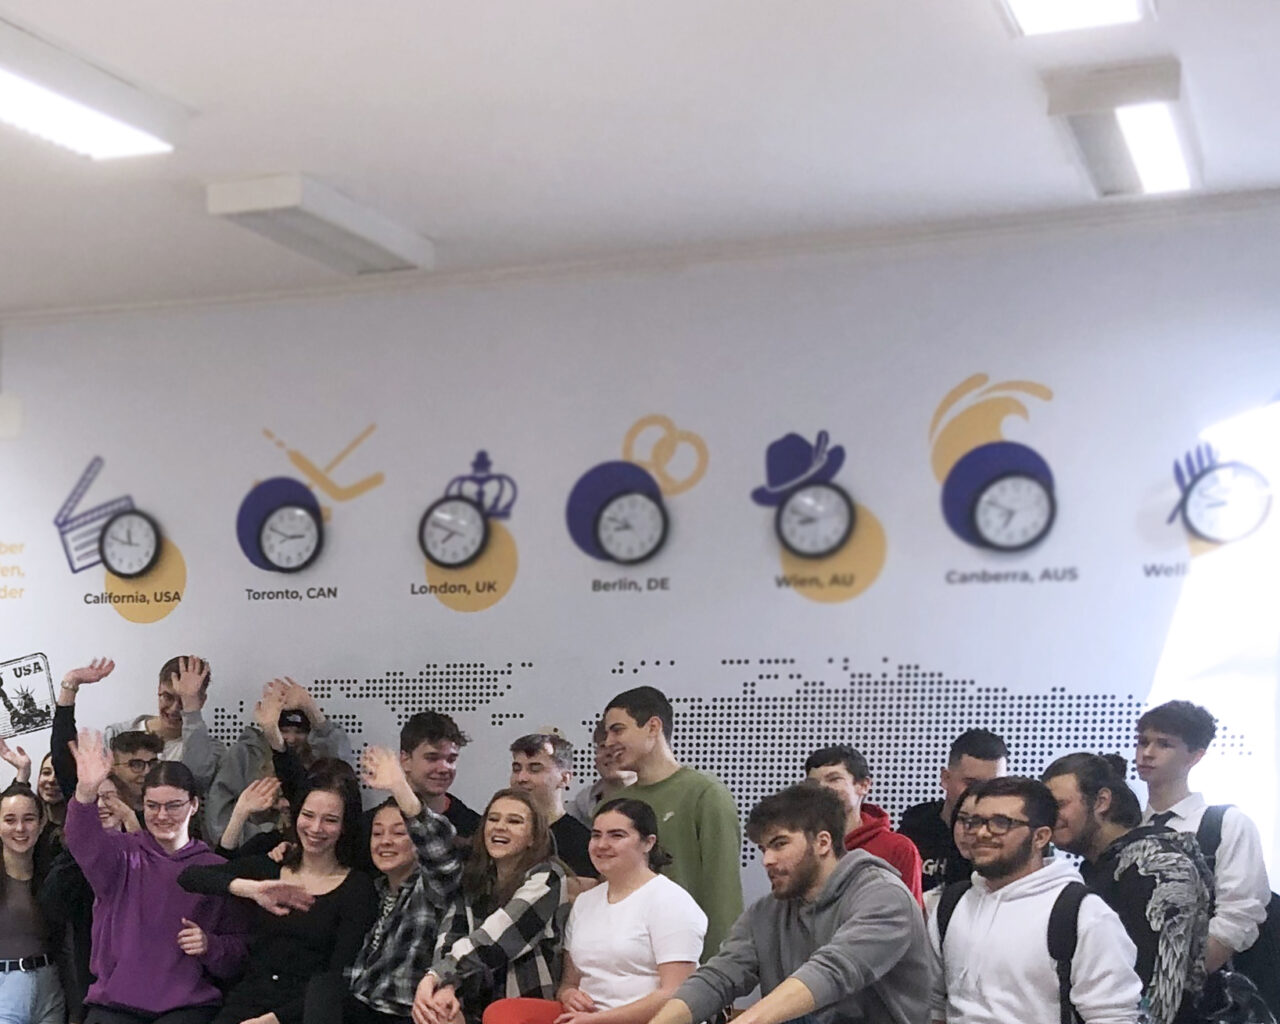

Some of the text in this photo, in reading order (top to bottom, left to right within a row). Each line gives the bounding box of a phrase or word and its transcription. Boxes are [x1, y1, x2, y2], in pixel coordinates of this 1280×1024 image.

[775, 573, 855, 589] Wien, AU
[944, 566, 1079, 585] Canberra, AUS
[410, 580, 497, 596] London, UK
[592, 576, 670, 593] Berlin, DE
[83, 591, 182, 605] California, USA
[246, 586, 337, 602] Toronto, CAN
[12, 661, 44, 678] USA
